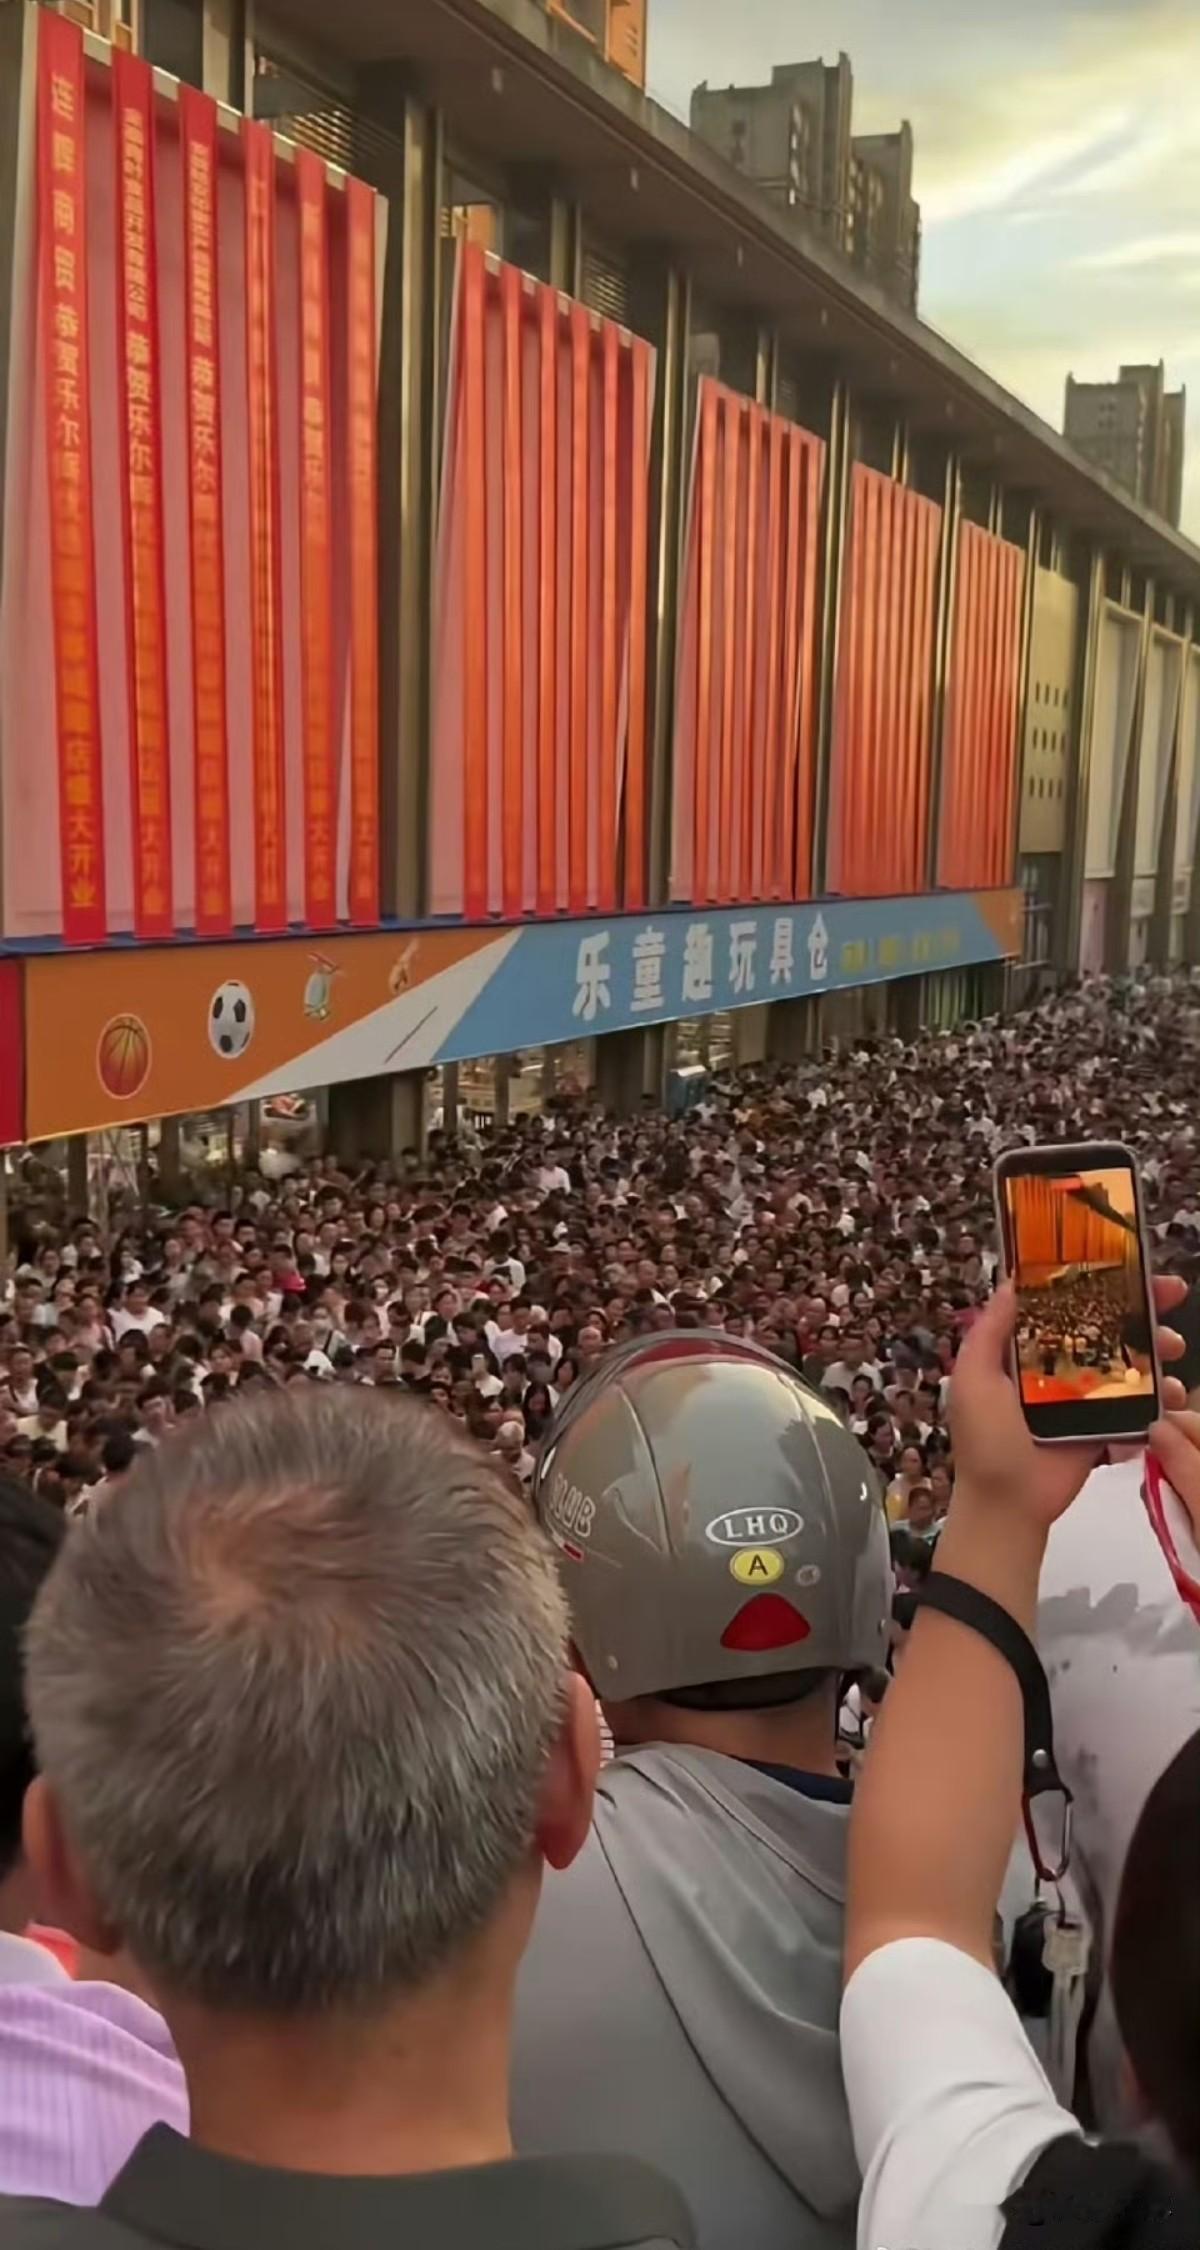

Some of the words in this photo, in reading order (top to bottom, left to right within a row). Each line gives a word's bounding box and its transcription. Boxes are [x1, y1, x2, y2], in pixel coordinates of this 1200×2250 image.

[572, 911, 829, 1021] 乐童趣玩具仓
[724, 1513, 788, 1538] LHQ
[748, 1554, 768, 1576] A
